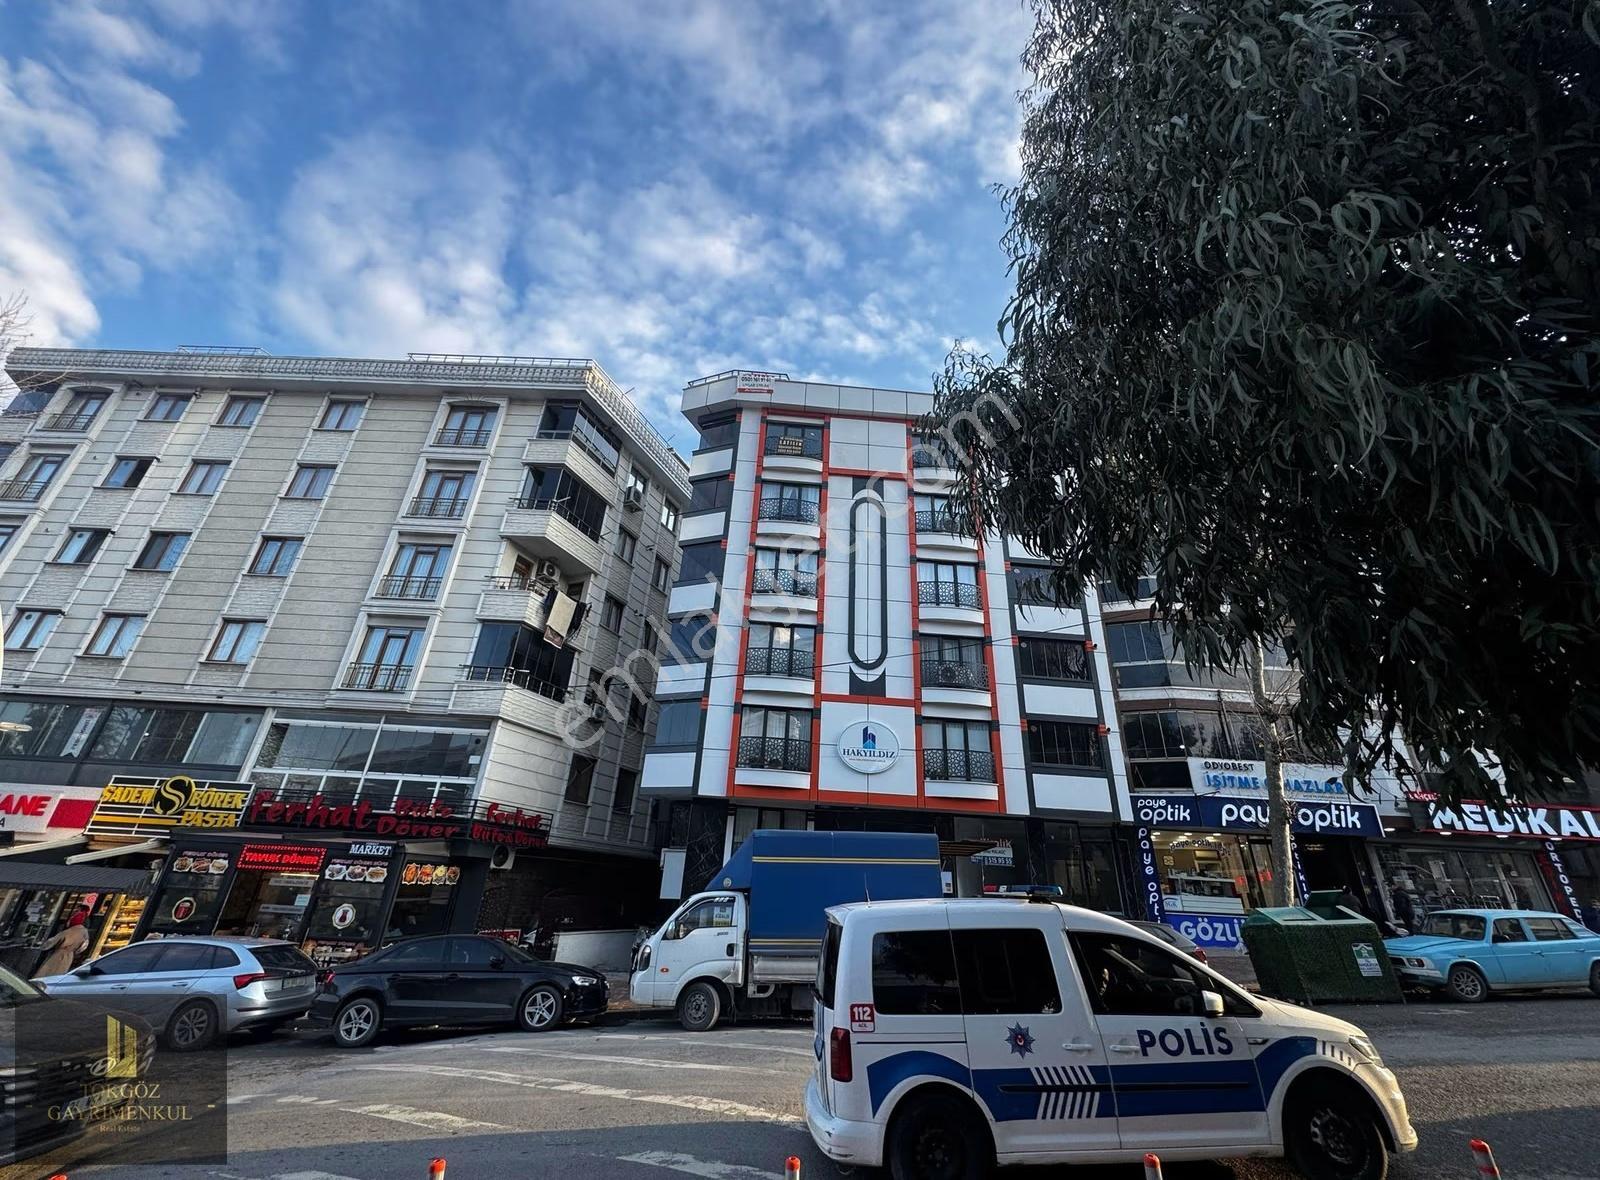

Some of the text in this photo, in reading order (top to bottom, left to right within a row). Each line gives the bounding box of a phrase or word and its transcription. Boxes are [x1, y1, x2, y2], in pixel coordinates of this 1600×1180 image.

[842, 748, 896, 759] HAKYILDIZ
[1204, 760, 1254, 772] ODYOBEST
[0, 794, 52, 816] ANE
[188, 788, 247, 809] BÖREK
[1137, 799, 1167, 808] paye
[182, 811, 237, 828] PASTA
[1140, 804, 1191, 825] optik
[1221, 802, 1361, 832] pay optik
[376, 815, 462, 838] Döner
[245, 852, 319, 865] TAVUK DÖNER
[349, 844, 392, 856] MARKET
[1138, 828, 1161, 924] paye opti
[853, 1006, 872, 1021] 112
[1136, 1021, 1233, 1057] POLİS
